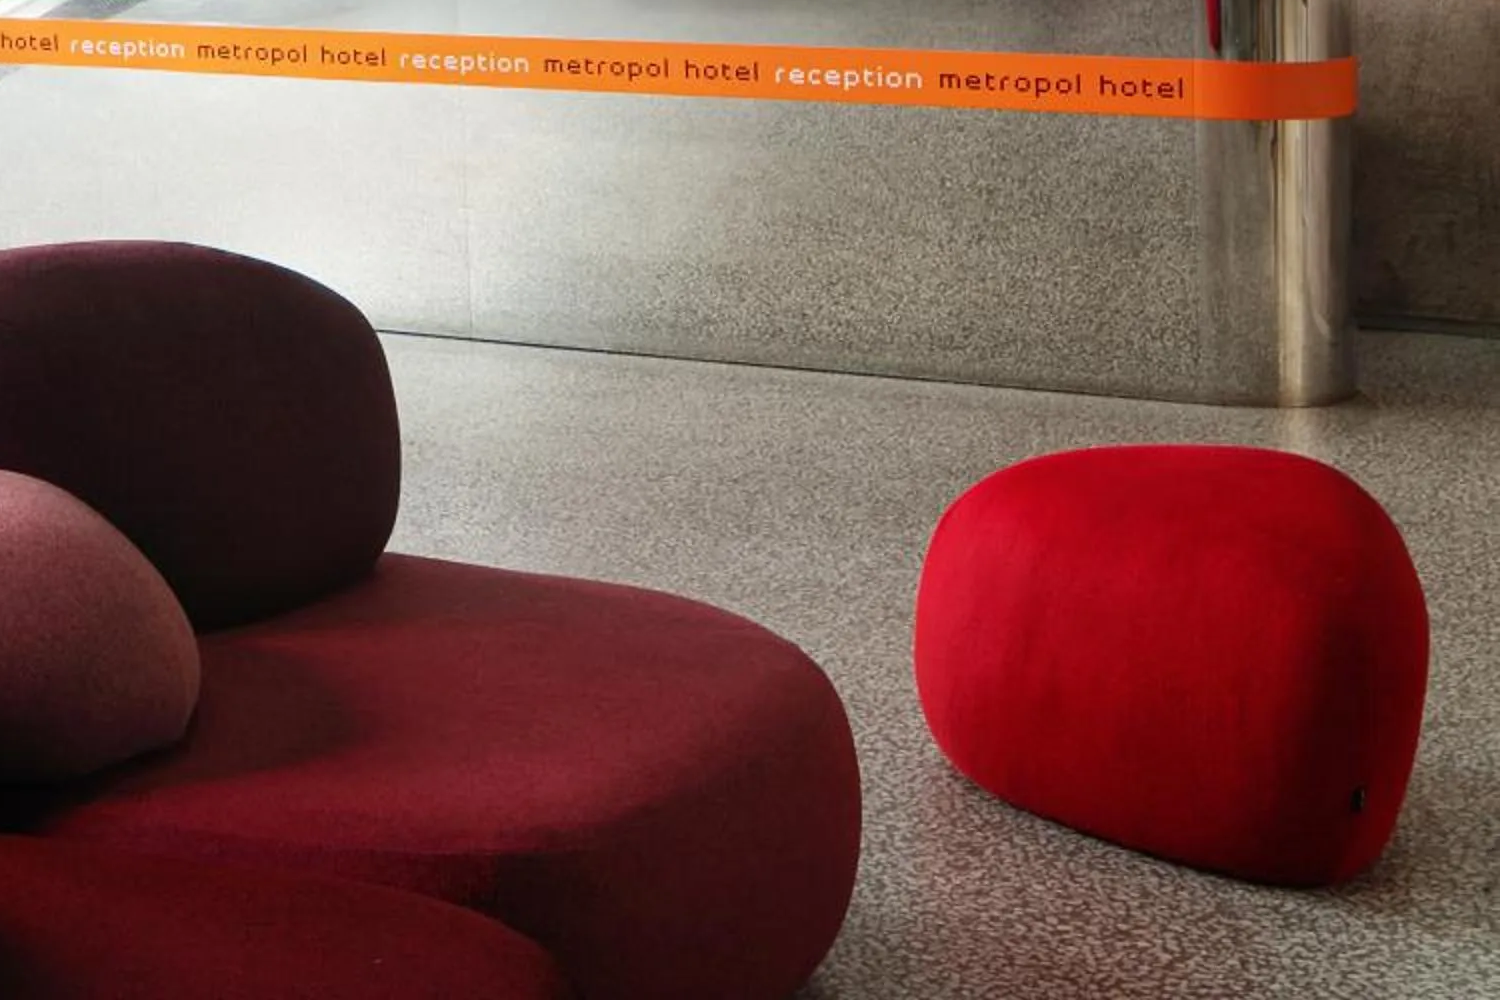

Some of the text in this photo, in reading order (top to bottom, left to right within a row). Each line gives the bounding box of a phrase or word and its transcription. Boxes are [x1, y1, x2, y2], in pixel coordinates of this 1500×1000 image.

[0, 33, 59, 52] hotel
[69, 37, 186, 61] reception
[196, 43, 308, 66] metropol
[320, 46, 387, 68] hotel
[399, 52, 530, 76] reception
[543, 56, 669, 81] metropol
[684, 60, 760, 82] hotel
[774, 65, 924, 91] reception
[938, 70, 1082, 98] metropol
[1098, 74, 1185, 99] hotel
